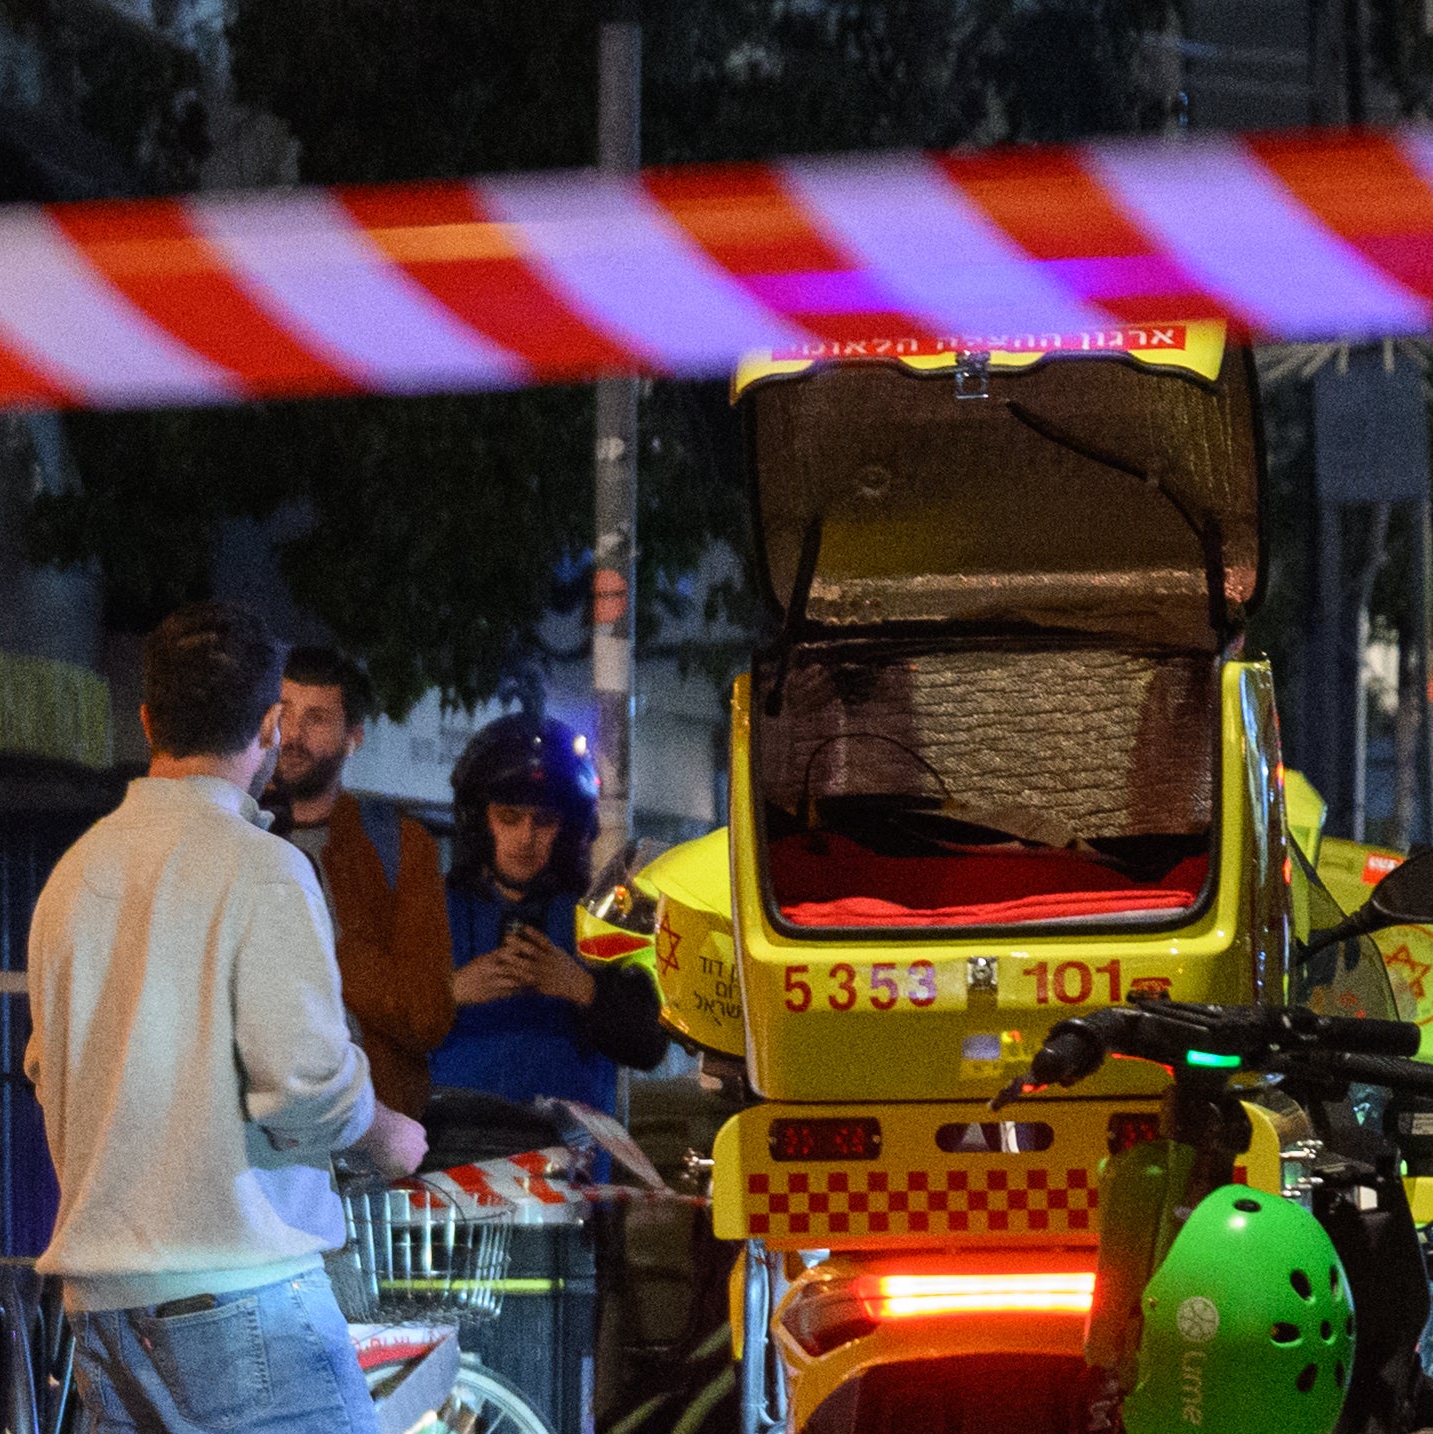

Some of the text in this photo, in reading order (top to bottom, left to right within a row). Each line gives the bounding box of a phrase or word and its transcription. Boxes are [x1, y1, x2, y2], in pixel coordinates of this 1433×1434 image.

[1080, 328, 1174, 351] ארגון
[699, 956, 724, 977] דוד
[1023, 959, 1123, 1005] 101
[784, 959, 938, 1013] 5353
